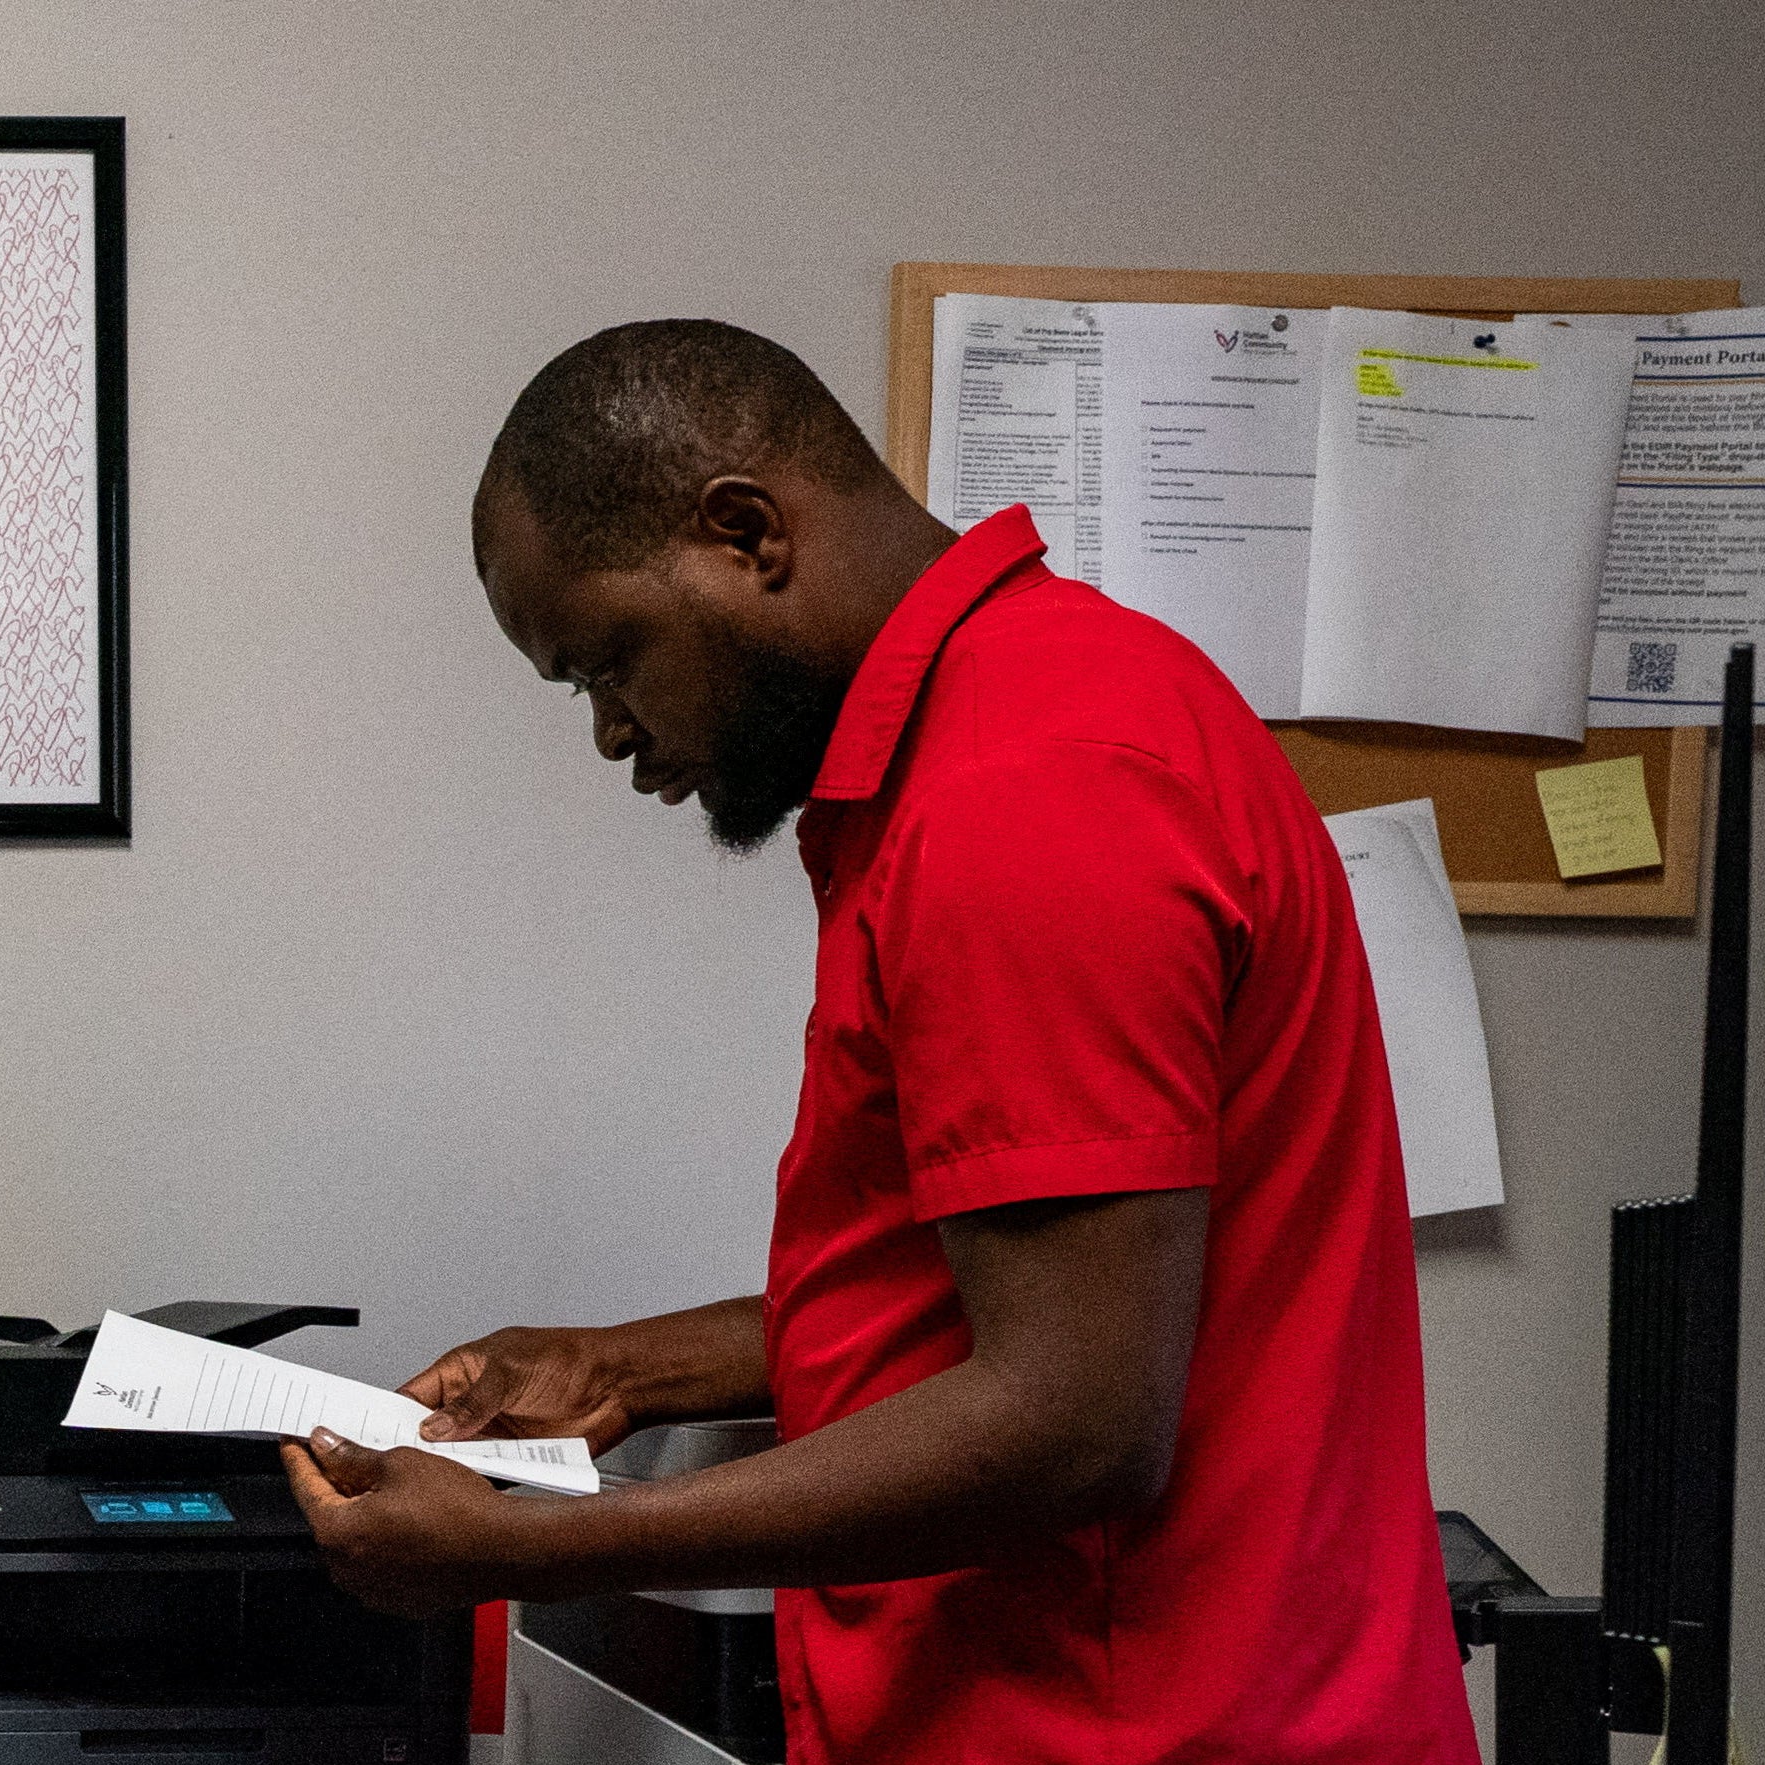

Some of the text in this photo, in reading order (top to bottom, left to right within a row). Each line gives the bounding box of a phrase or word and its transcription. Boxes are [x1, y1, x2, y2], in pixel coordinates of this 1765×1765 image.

[1243, 340, 1288, 350] Community
[1642, 349, 1765, 369] Payment Porta
[1343, 851, 1370, 862] OURT
